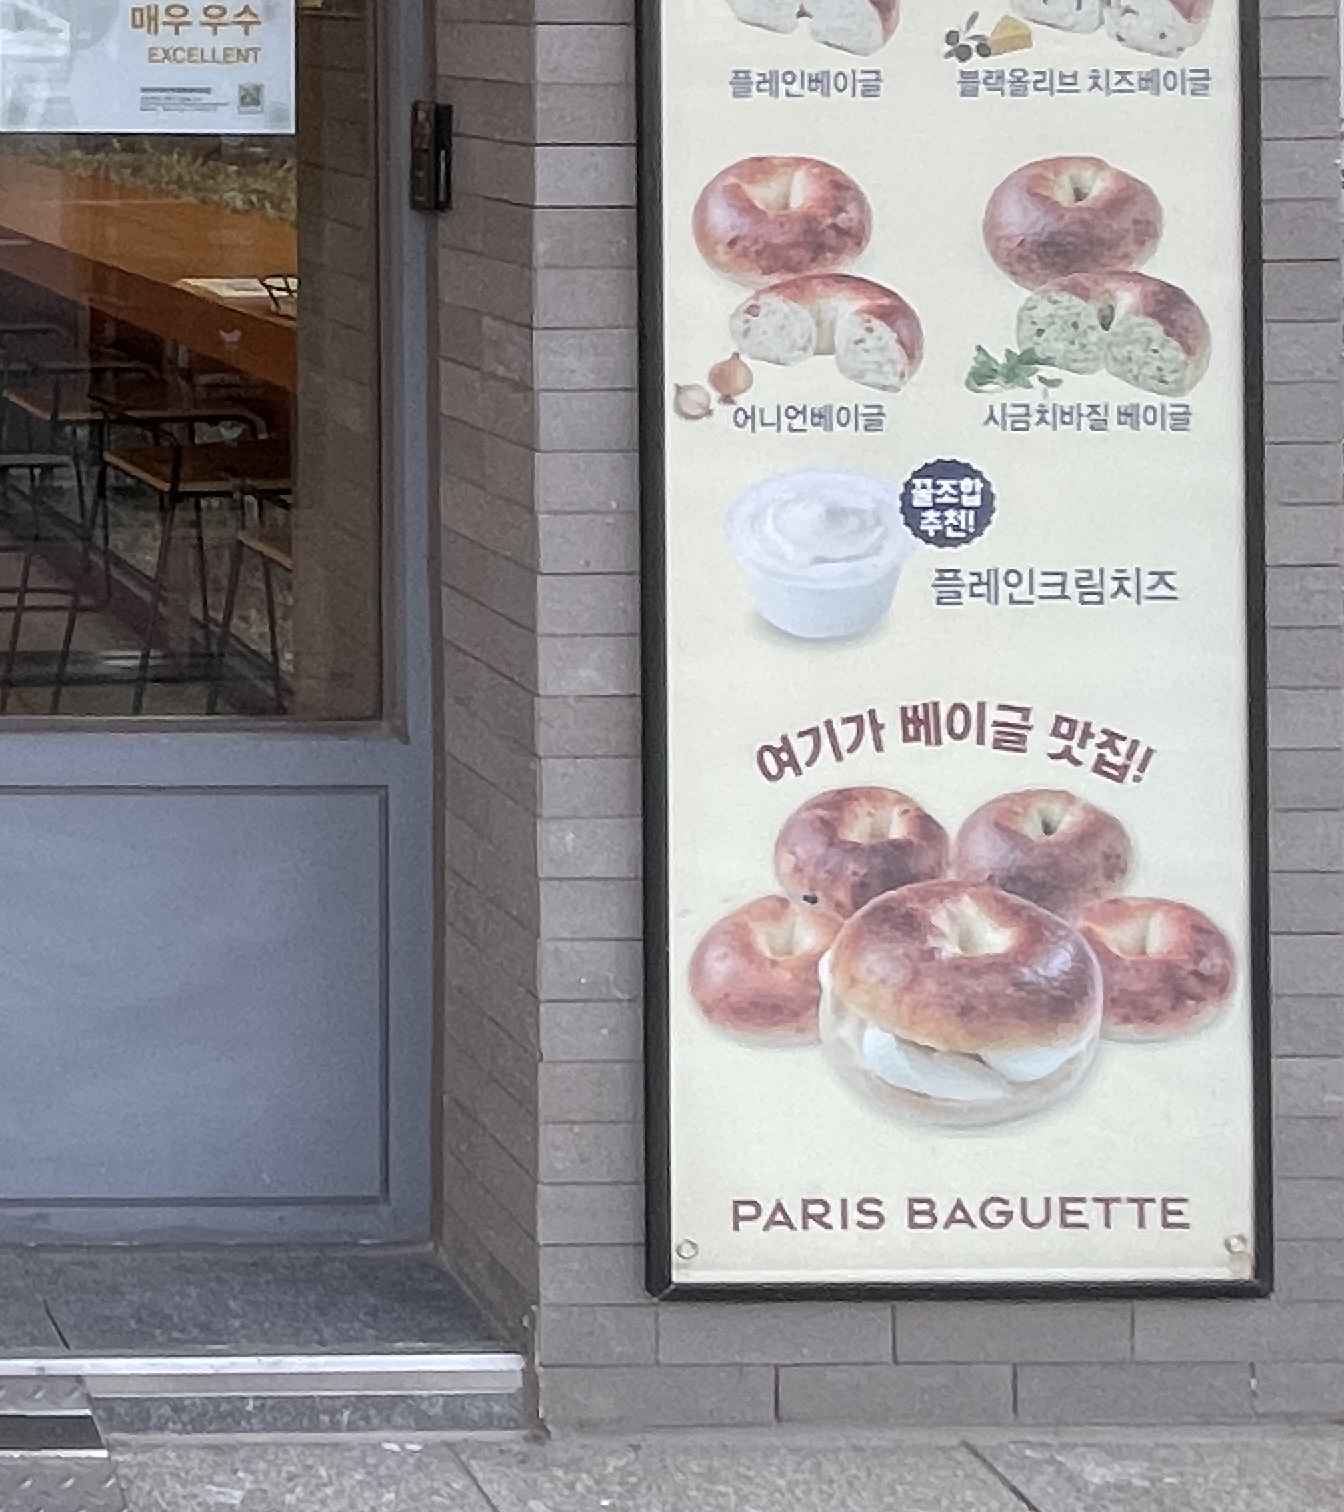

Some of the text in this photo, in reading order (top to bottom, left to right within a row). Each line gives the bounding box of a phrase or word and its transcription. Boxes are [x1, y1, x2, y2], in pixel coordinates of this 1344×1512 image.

[130, 4, 262, 36] 매우 우수
[148, 46, 262, 64] EXCELLENT
[733, 403, 886, 434] 어니언베이글
[983, 402, 1193, 433] 시금치바질 베이글
[920, 509, 976, 537] 추천!
[931, 567, 1180, 607] 플레인크림치즈
[755, 700, 1158, 785] 여기가 베이글 맛집!
[732, 1196, 1191, 1233] PARIS BAGUETTE
